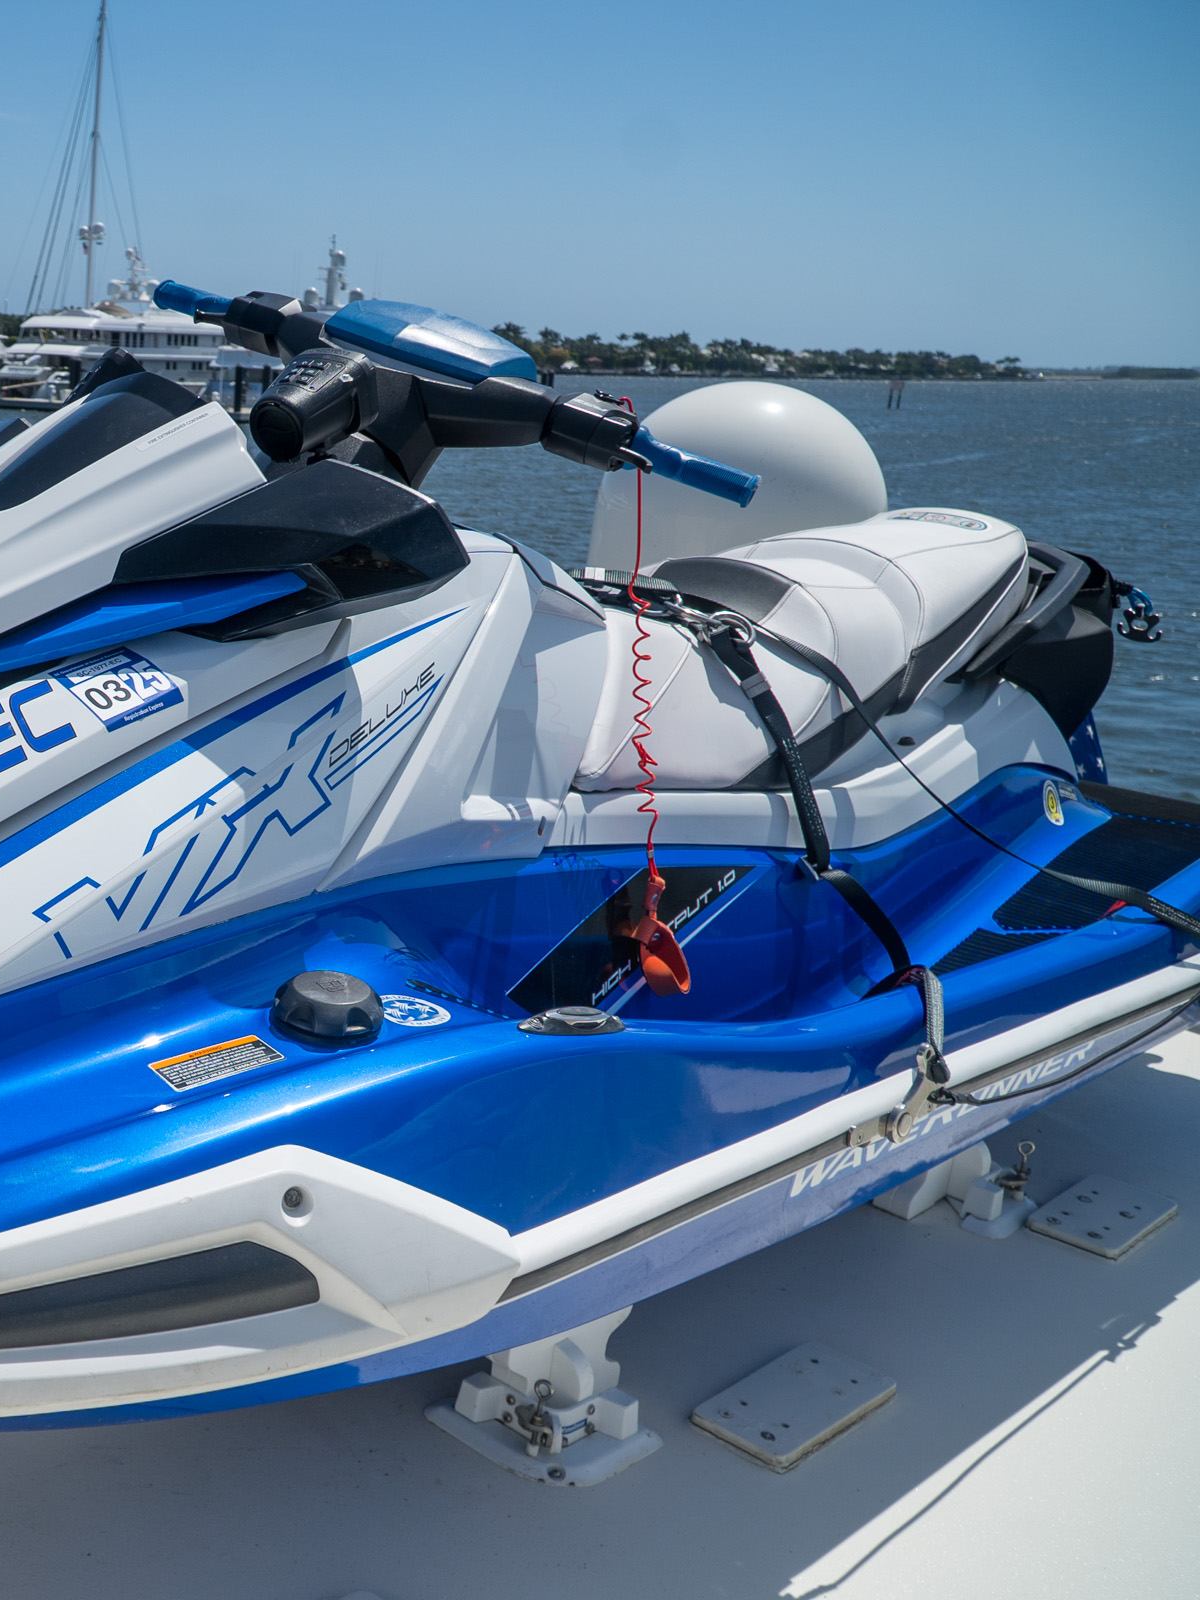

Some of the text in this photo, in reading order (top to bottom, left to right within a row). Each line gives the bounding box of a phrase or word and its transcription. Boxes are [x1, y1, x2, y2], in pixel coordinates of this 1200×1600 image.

[76, 658, 122, 678] SC-1977-EC
[84, 660, 172, 710] 03 25
[328, 662, 436, 768] DELUXE
[592, 959, 631, 1006] HIGH
[717, 869, 736, 892] 1.0
